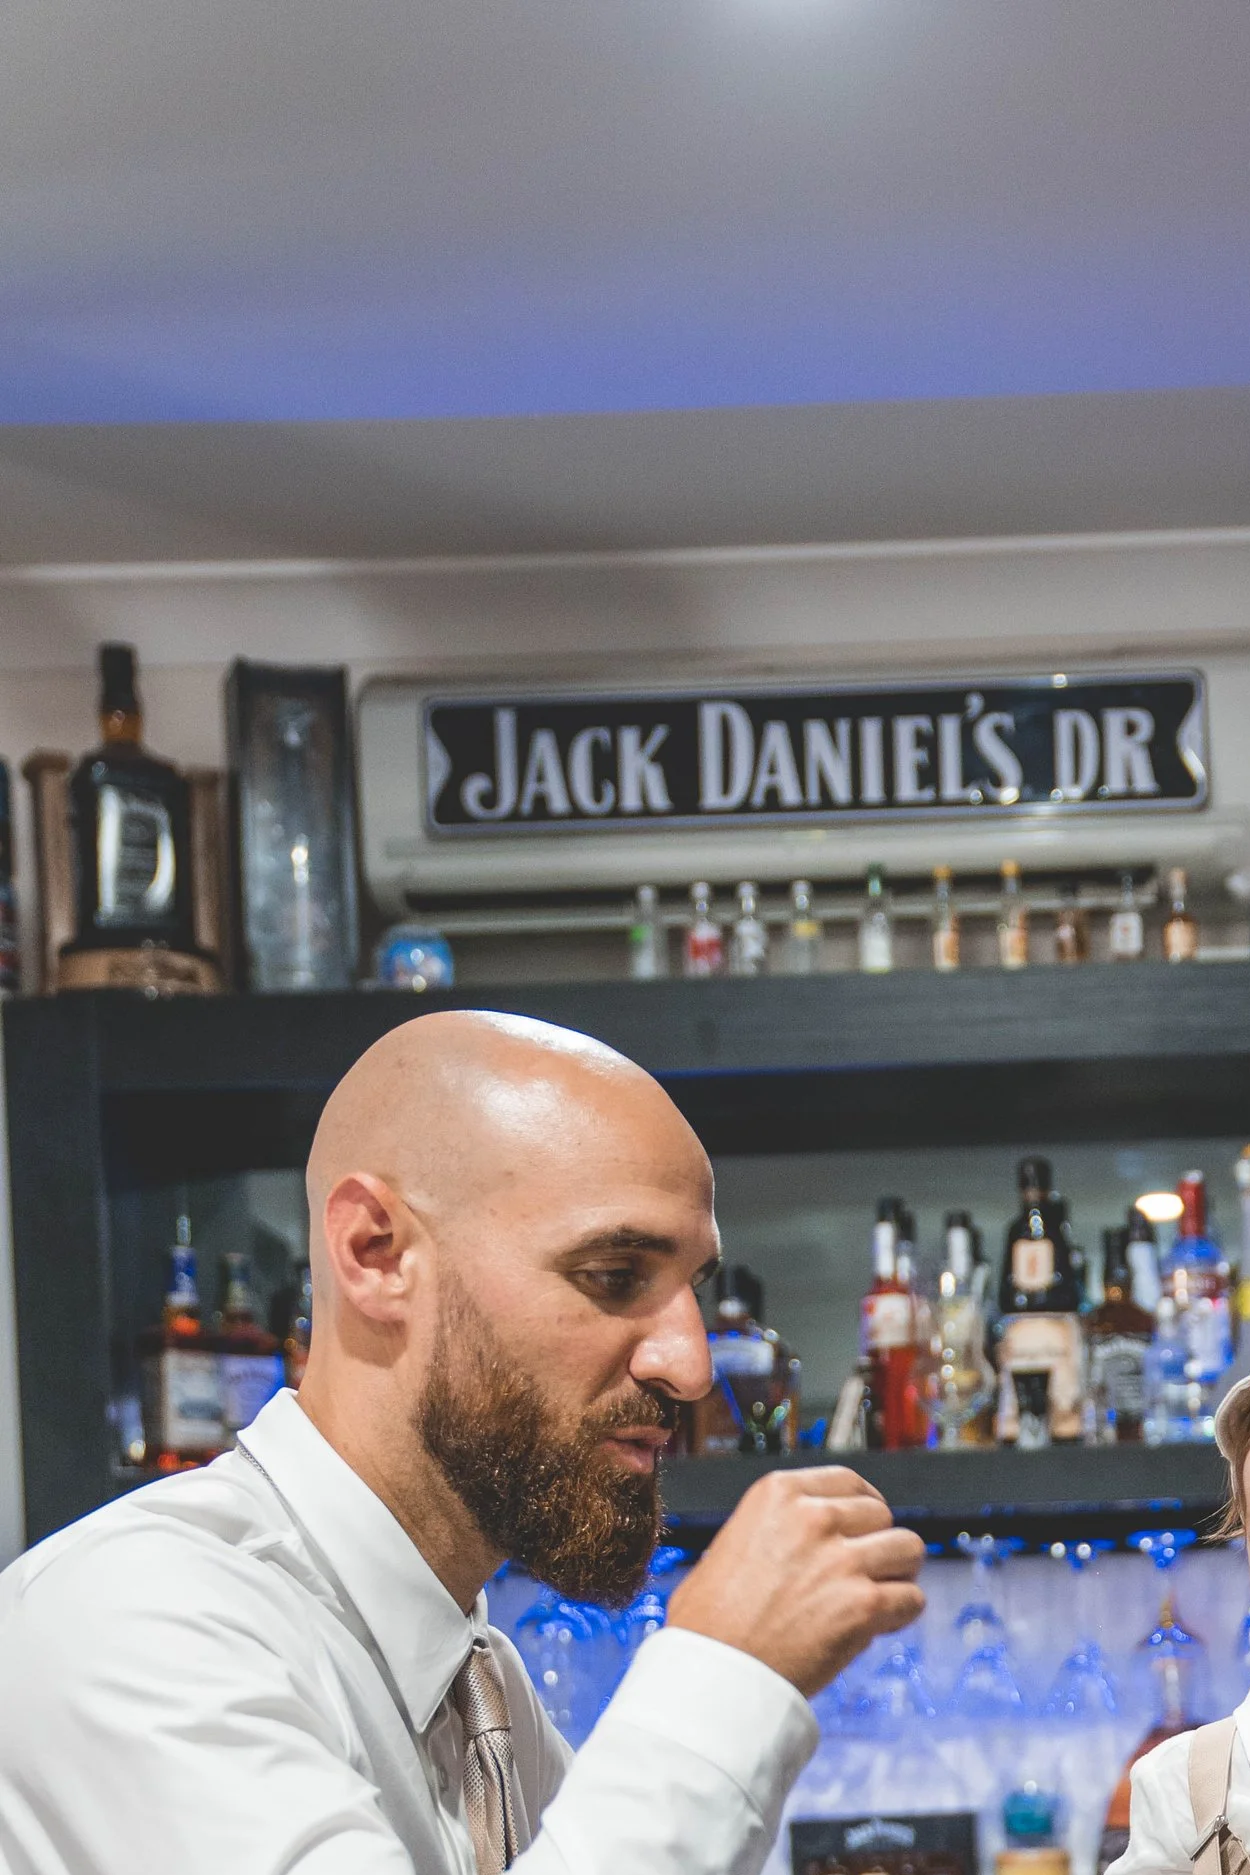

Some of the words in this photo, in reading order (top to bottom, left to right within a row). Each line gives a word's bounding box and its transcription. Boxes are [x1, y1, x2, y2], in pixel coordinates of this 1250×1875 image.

[460, 706, 673, 821] JACK
[698, 691, 1023, 811] DANIEL'S
[1053, 706, 1161, 803] DR
